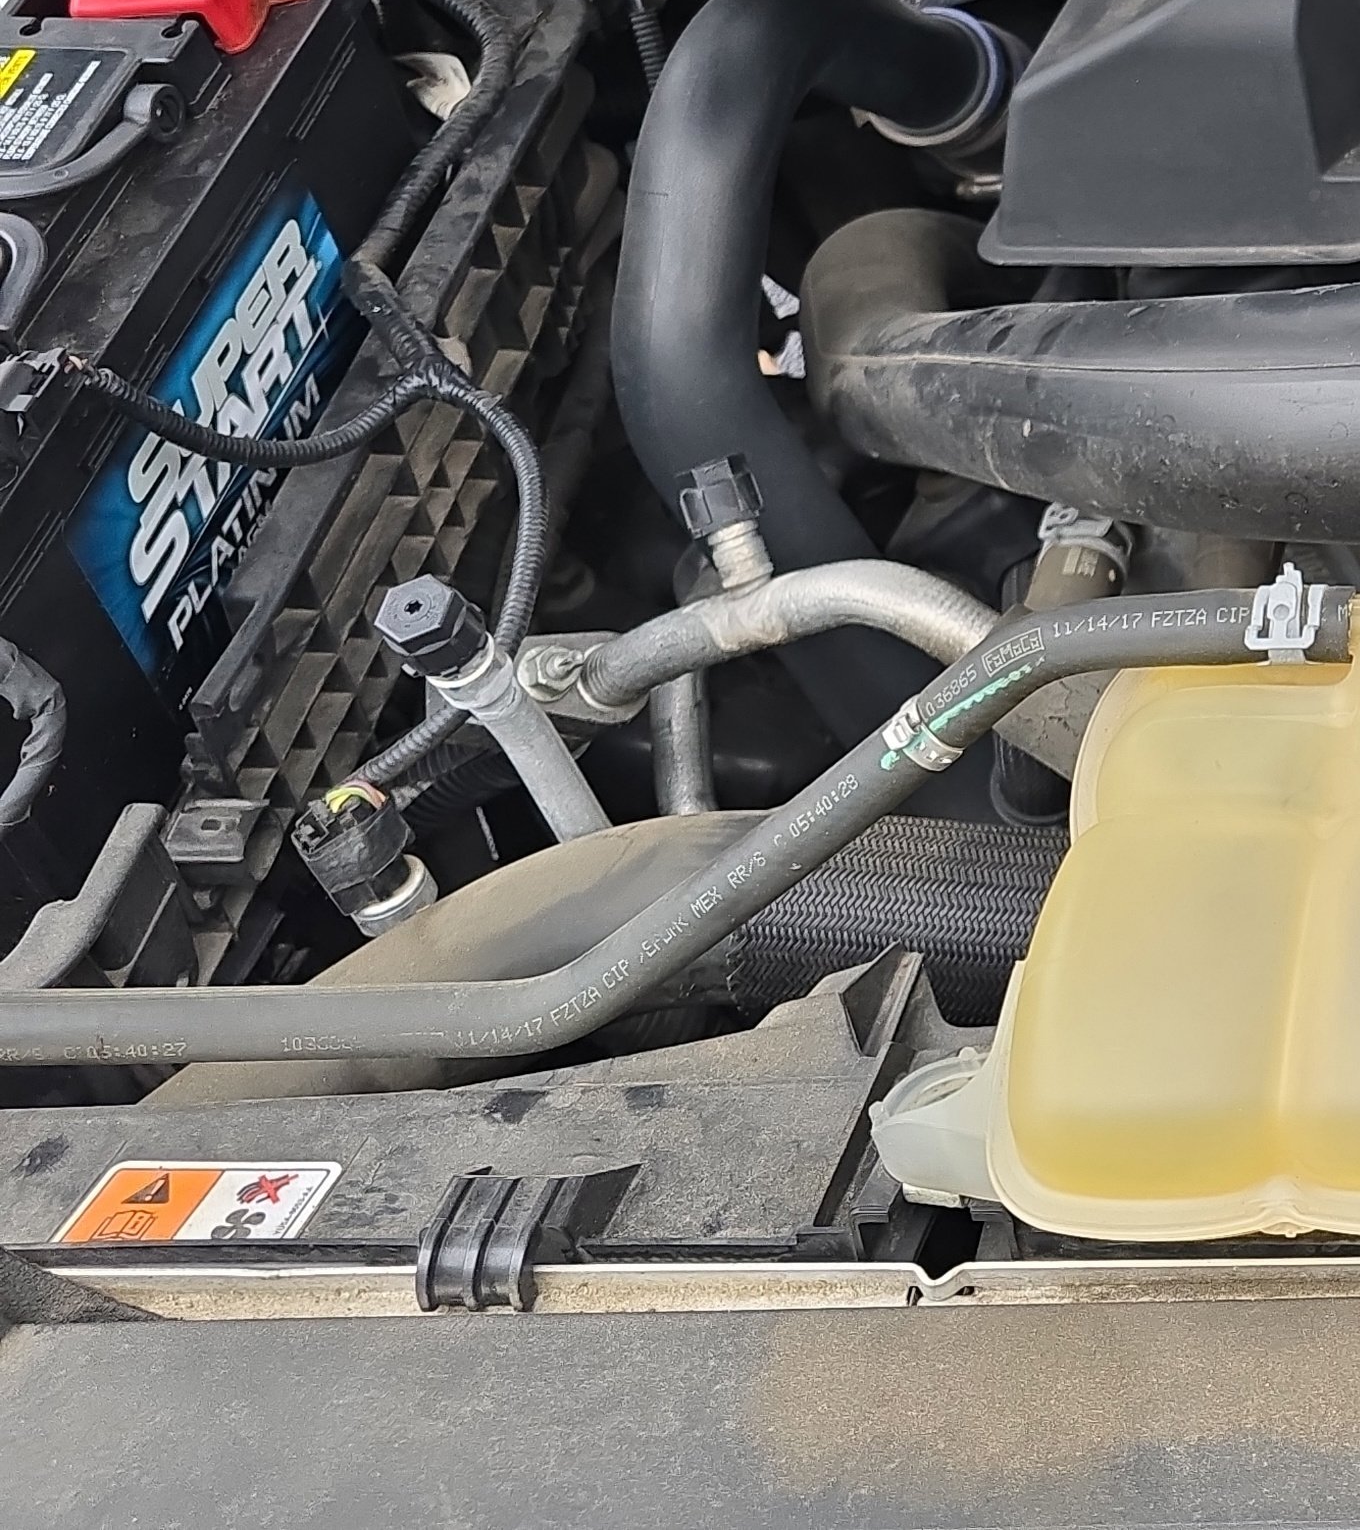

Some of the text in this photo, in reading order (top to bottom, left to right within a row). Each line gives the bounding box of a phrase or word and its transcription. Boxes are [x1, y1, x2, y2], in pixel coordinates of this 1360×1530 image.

[128, 217, 309, 504] SUPER
[130, 258, 322, 624] START
[167, 372, 322, 653] PLATINM
[550, 986, 602, 1027] FZTZA
[602, 958, 631, 990] CIP
[689, 885, 724, 920] MEX
[788, 773, 859, 839] 05:40:28
[985, 633, 1042, 673] FoMoCo
[1052, 612, 1143, 639] 11/14/17
[1151, 607, 1208, 628] FZTZA
